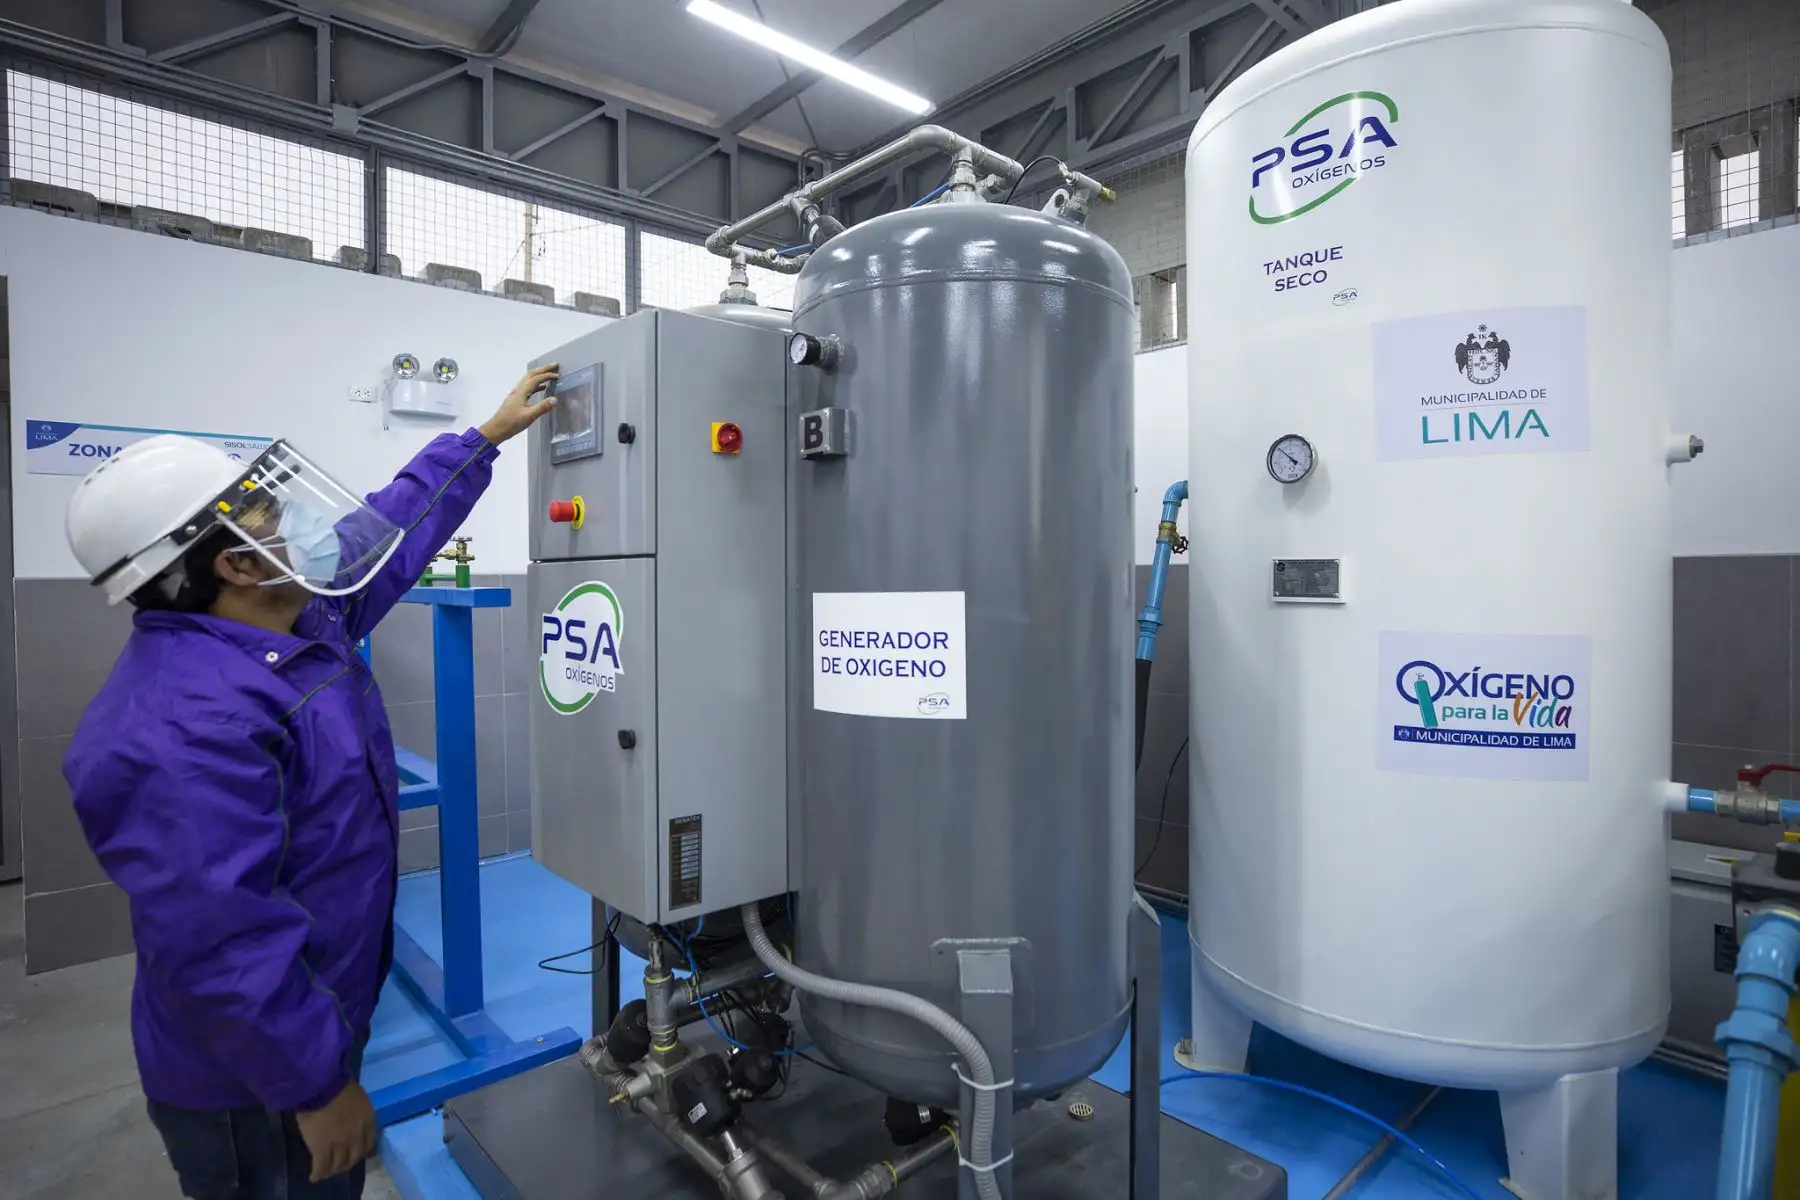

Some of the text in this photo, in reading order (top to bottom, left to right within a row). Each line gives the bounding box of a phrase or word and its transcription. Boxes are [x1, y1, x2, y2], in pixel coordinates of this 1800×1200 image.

[1252, 116, 1398, 189] PSA
[1292, 155, 1386, 189] OXÍGENOS
[1263, 246, 1343, 276] TANQUE
[1274, 270, 1328, 292] SECO
[1333, 291, 1358, 301] PSA
[1421, 388, 1547, 406] MUNICIPALIDAD DE
[35, 433, 58, 441] LIMA
[804, 415, 823, 451] B
[1421, 408, 1550, 445] LIMA
[543, 615, 620, 669] PSA
[819, 630, 949, 649] GENERADOR
[565, 665, 614, 690] OXÍGENOS
[821, 656, 946, 678] DE OXIGENO
[1396, 660, 1575, 705] OXÍGENO
[918, 697, 950, 706] PSA
[1442, 691, 1573, 729] para la Vida
[1416, 730, 1572, 747] MUNICIPALIDAD DE LIMA
